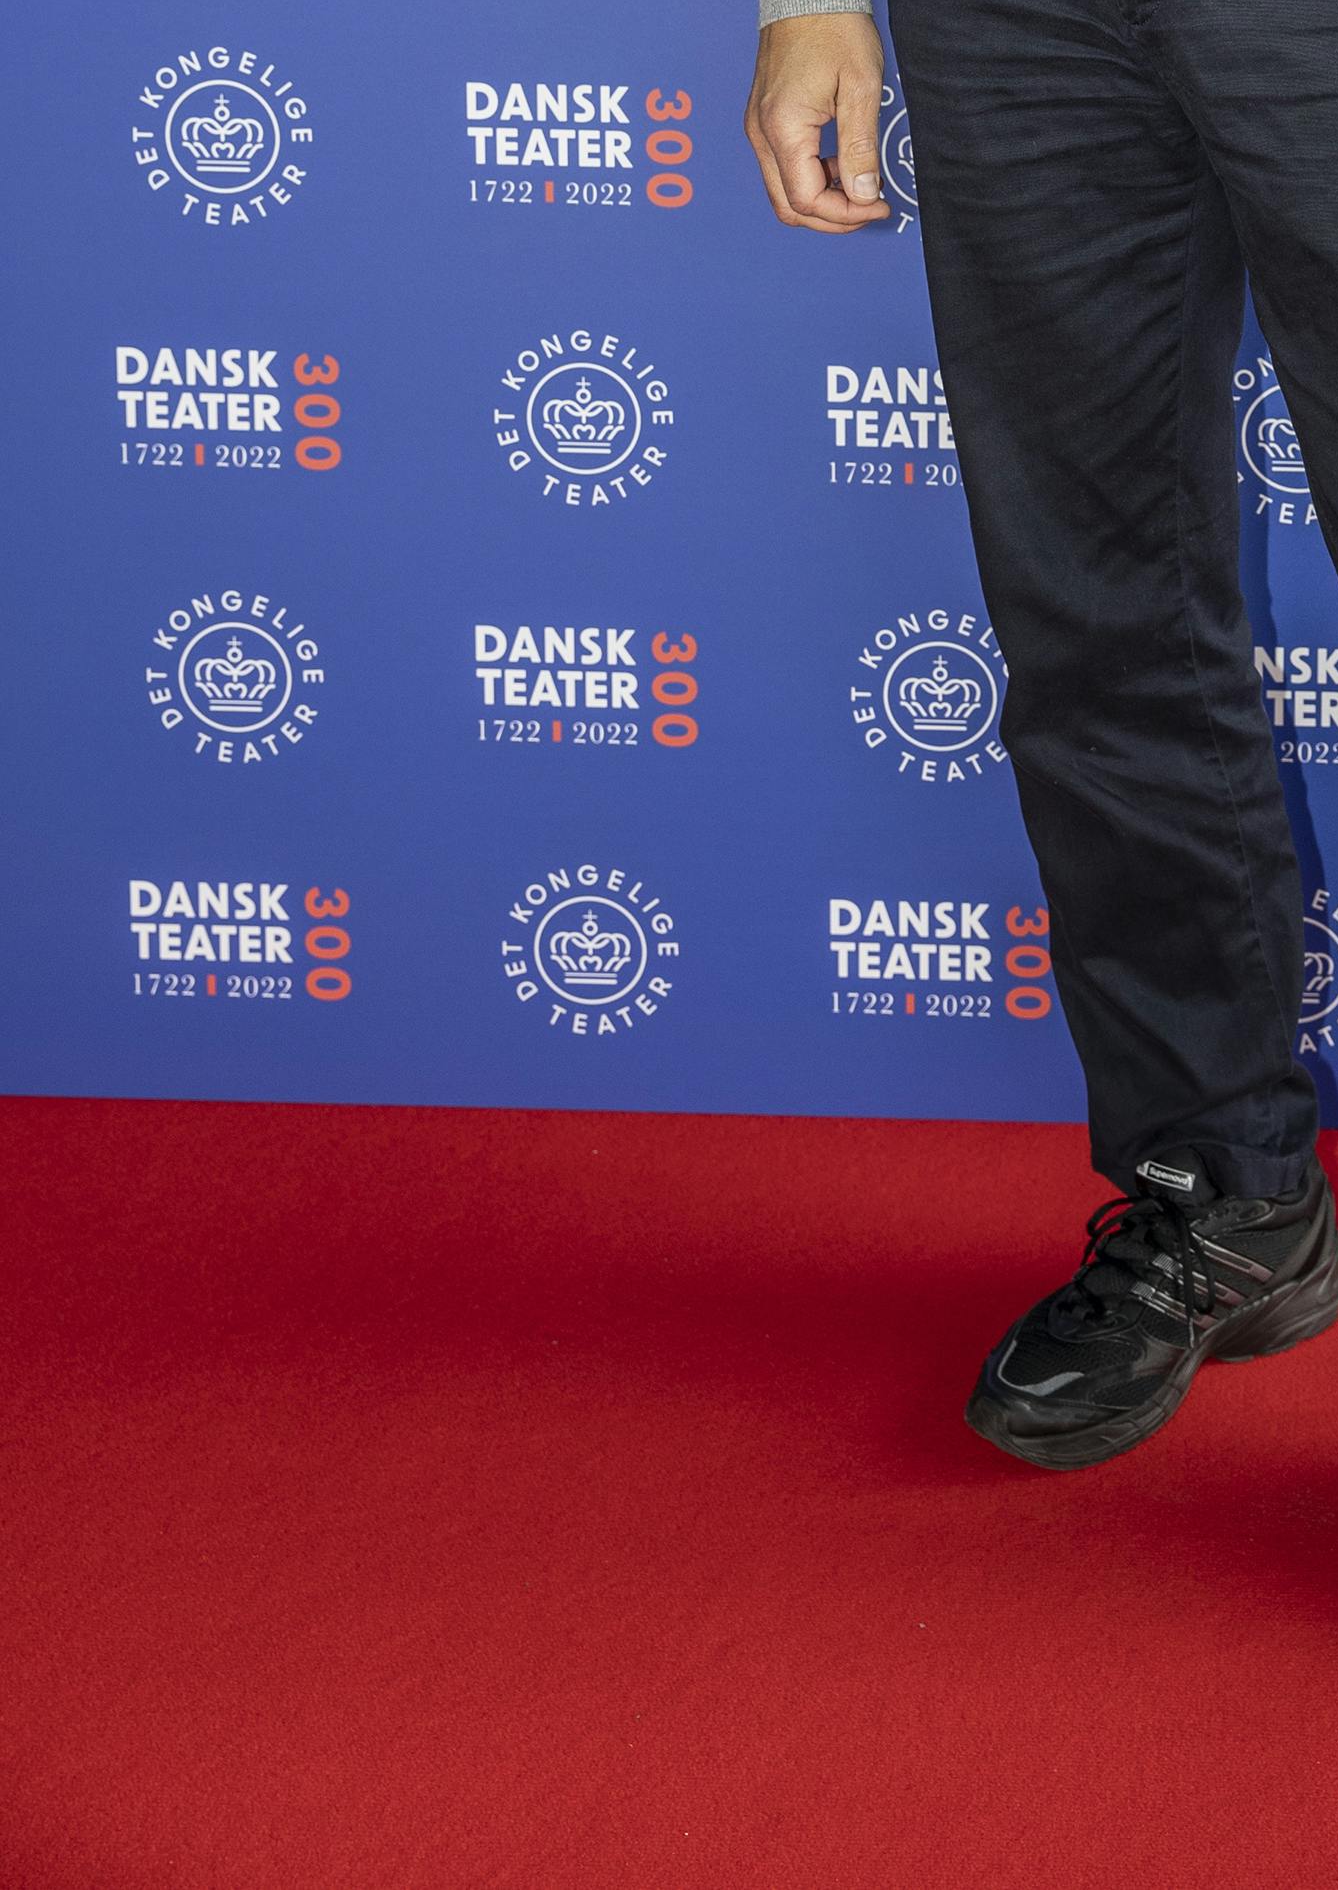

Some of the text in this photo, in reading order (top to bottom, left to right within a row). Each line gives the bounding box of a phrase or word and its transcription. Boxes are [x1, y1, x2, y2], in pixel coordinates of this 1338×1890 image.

[131, 46, 314, 226] DET KONGELIGE TEATER
[115, 346, 279, 389] DANSK
[116, 389, 283, 433] TEATER
[292, 352, 343, 472] 300
[826, 408, 957, 451] TEATE
[120, 442, 282, 469] 1722 2022
[829, 461, 894, 486] 1722
[474, 624, 637, 667] DANSK
[475, 667, 640, 710] TEATER
[650, 630, 700, 748] 300
[478, 718, 639, 746] 1722 2022
[850, 685, 1009, 783] DET TEATE
[128, 879, 290, 922] DANSK
[828, 898, 991, 940] DANSK
[129, 921, 294, 964] TEATER
[303, 885, 353, 1002] 300
[501, 864, 680, 1036] DET KONGELIGE TEATER
[829, 940, 994, 983] TEATER
[1004, 905, 1052, 1021] 300
[133, 973, 293, 999] 1722 2022
[832, 991, 992, 1018] 1722 2022
